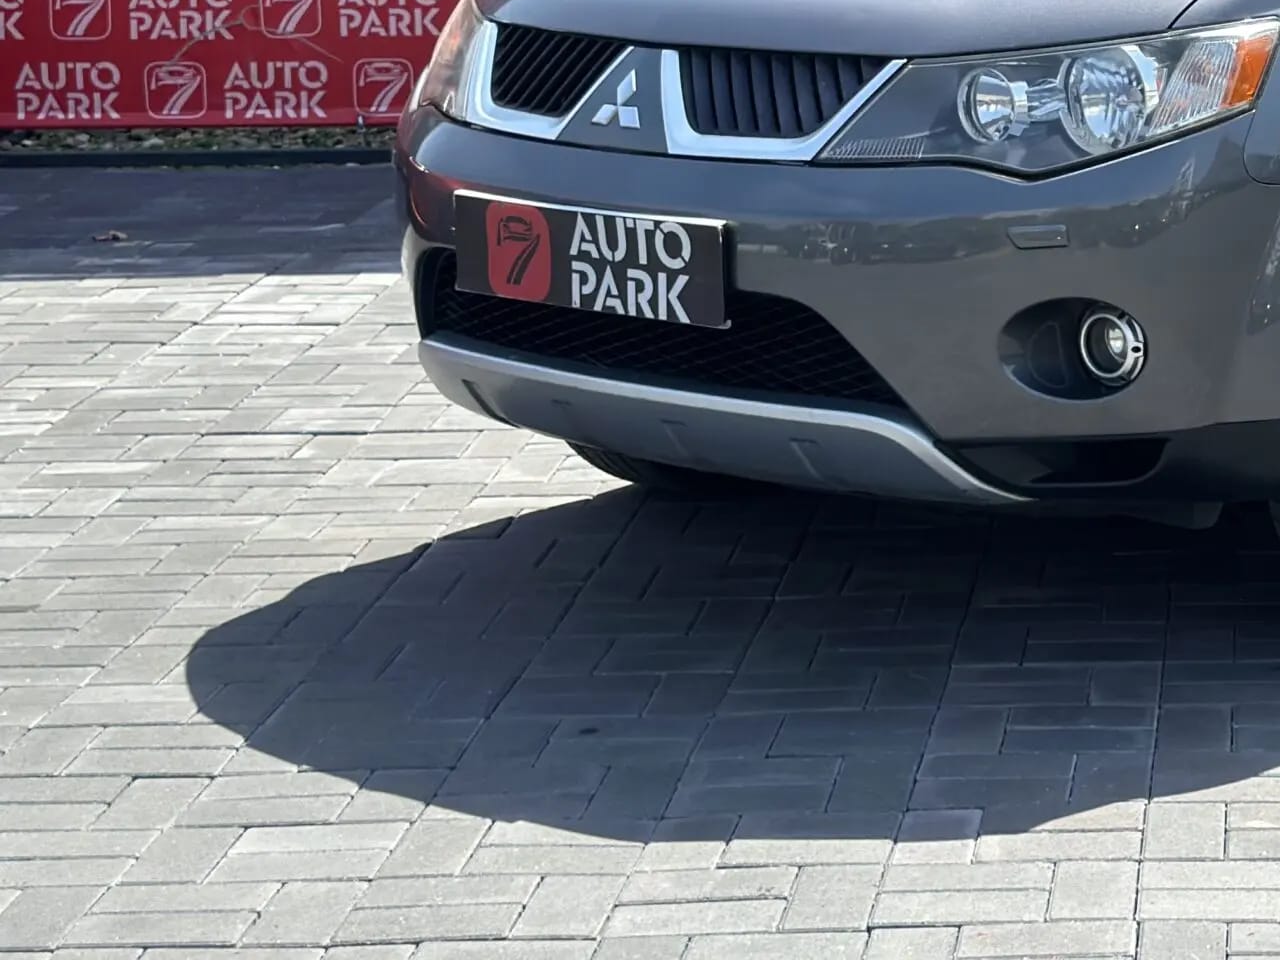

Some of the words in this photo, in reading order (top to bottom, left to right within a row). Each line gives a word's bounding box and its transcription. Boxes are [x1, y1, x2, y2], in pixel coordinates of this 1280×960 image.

[130, 10, 233, 40] PARK
[340, 7, 440, 36] PARK
[16, 62, 120, 89] AUTO
[224, 61, 327, 88] AUTO
[17, 93, 120, 120] PARK
[225, 91, 326, 118] PARK
[569, 211, 692, 270] AUTO
[571, 260, 692, 324] PARK
